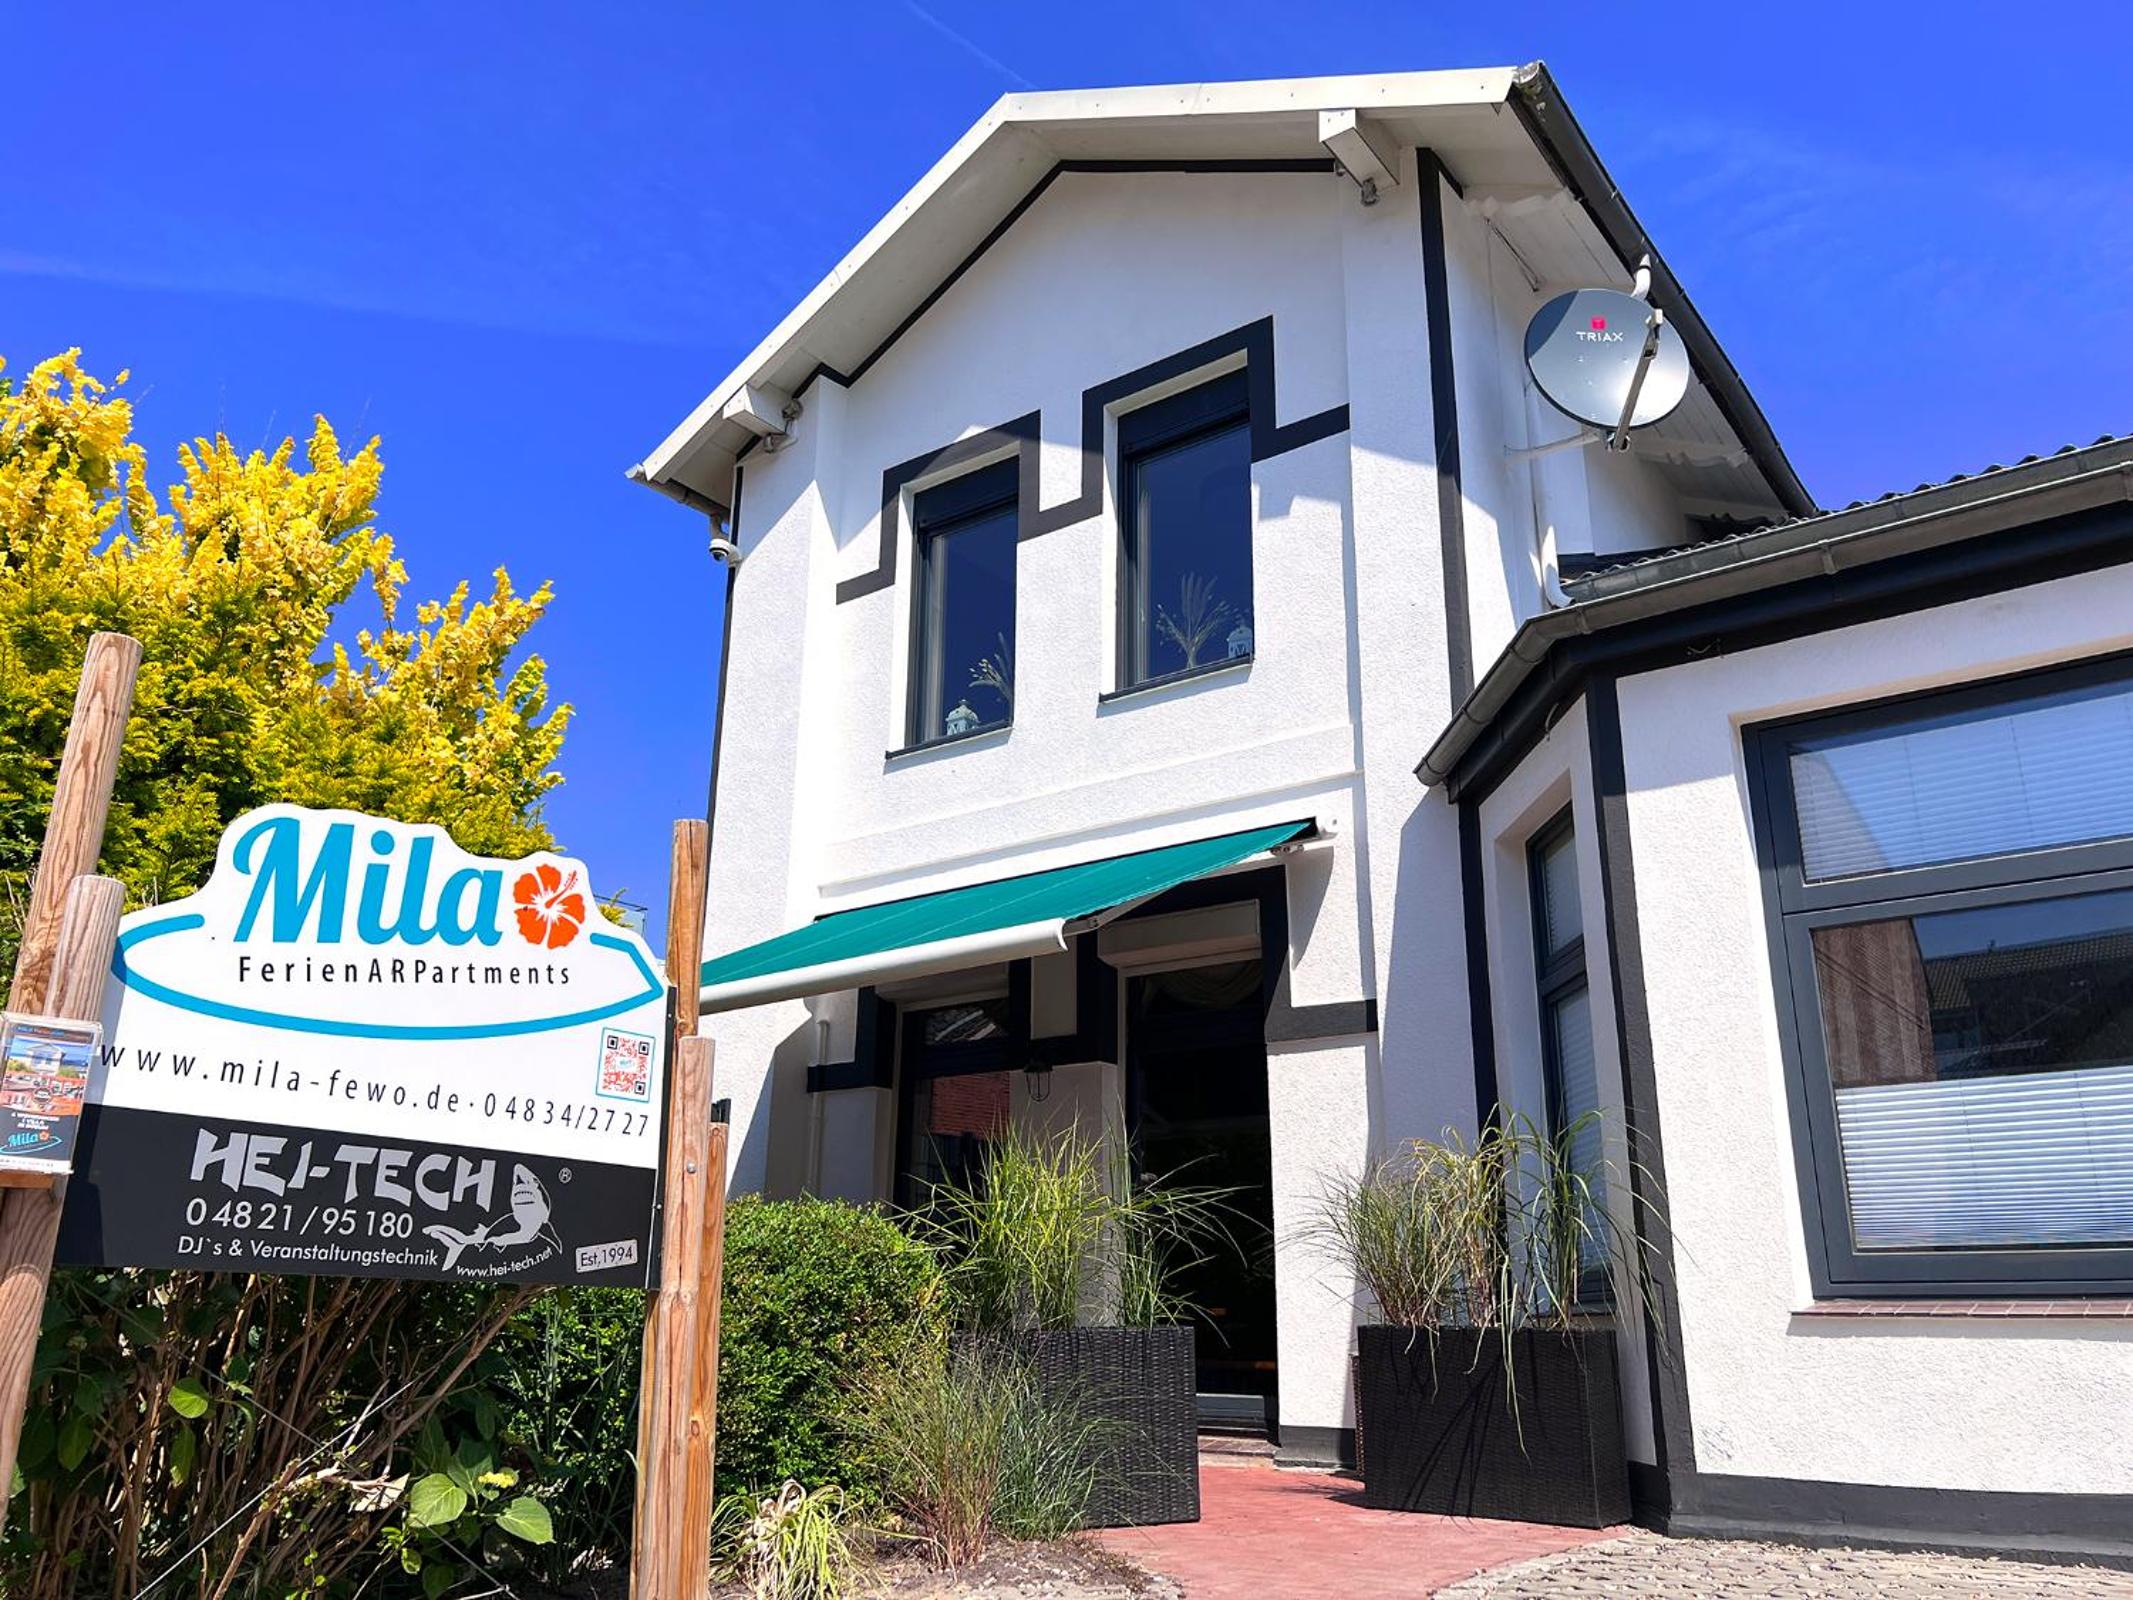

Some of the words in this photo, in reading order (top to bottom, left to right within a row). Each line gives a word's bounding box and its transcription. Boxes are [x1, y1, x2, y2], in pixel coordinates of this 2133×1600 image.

[1575, 331, 1624, 342] TRIAX
[233, 817, 503, 946] Mila
[239, 956, 570, 985] FerienARPartments
[190, 1128, 497, 1212] HEI-TECH
[228, 1239, 244, 1257] &
[250, 1239, 439, 1266] Veranstaltungstechnik
[456, 1246, 553, 1277] www.hei-tech.net
